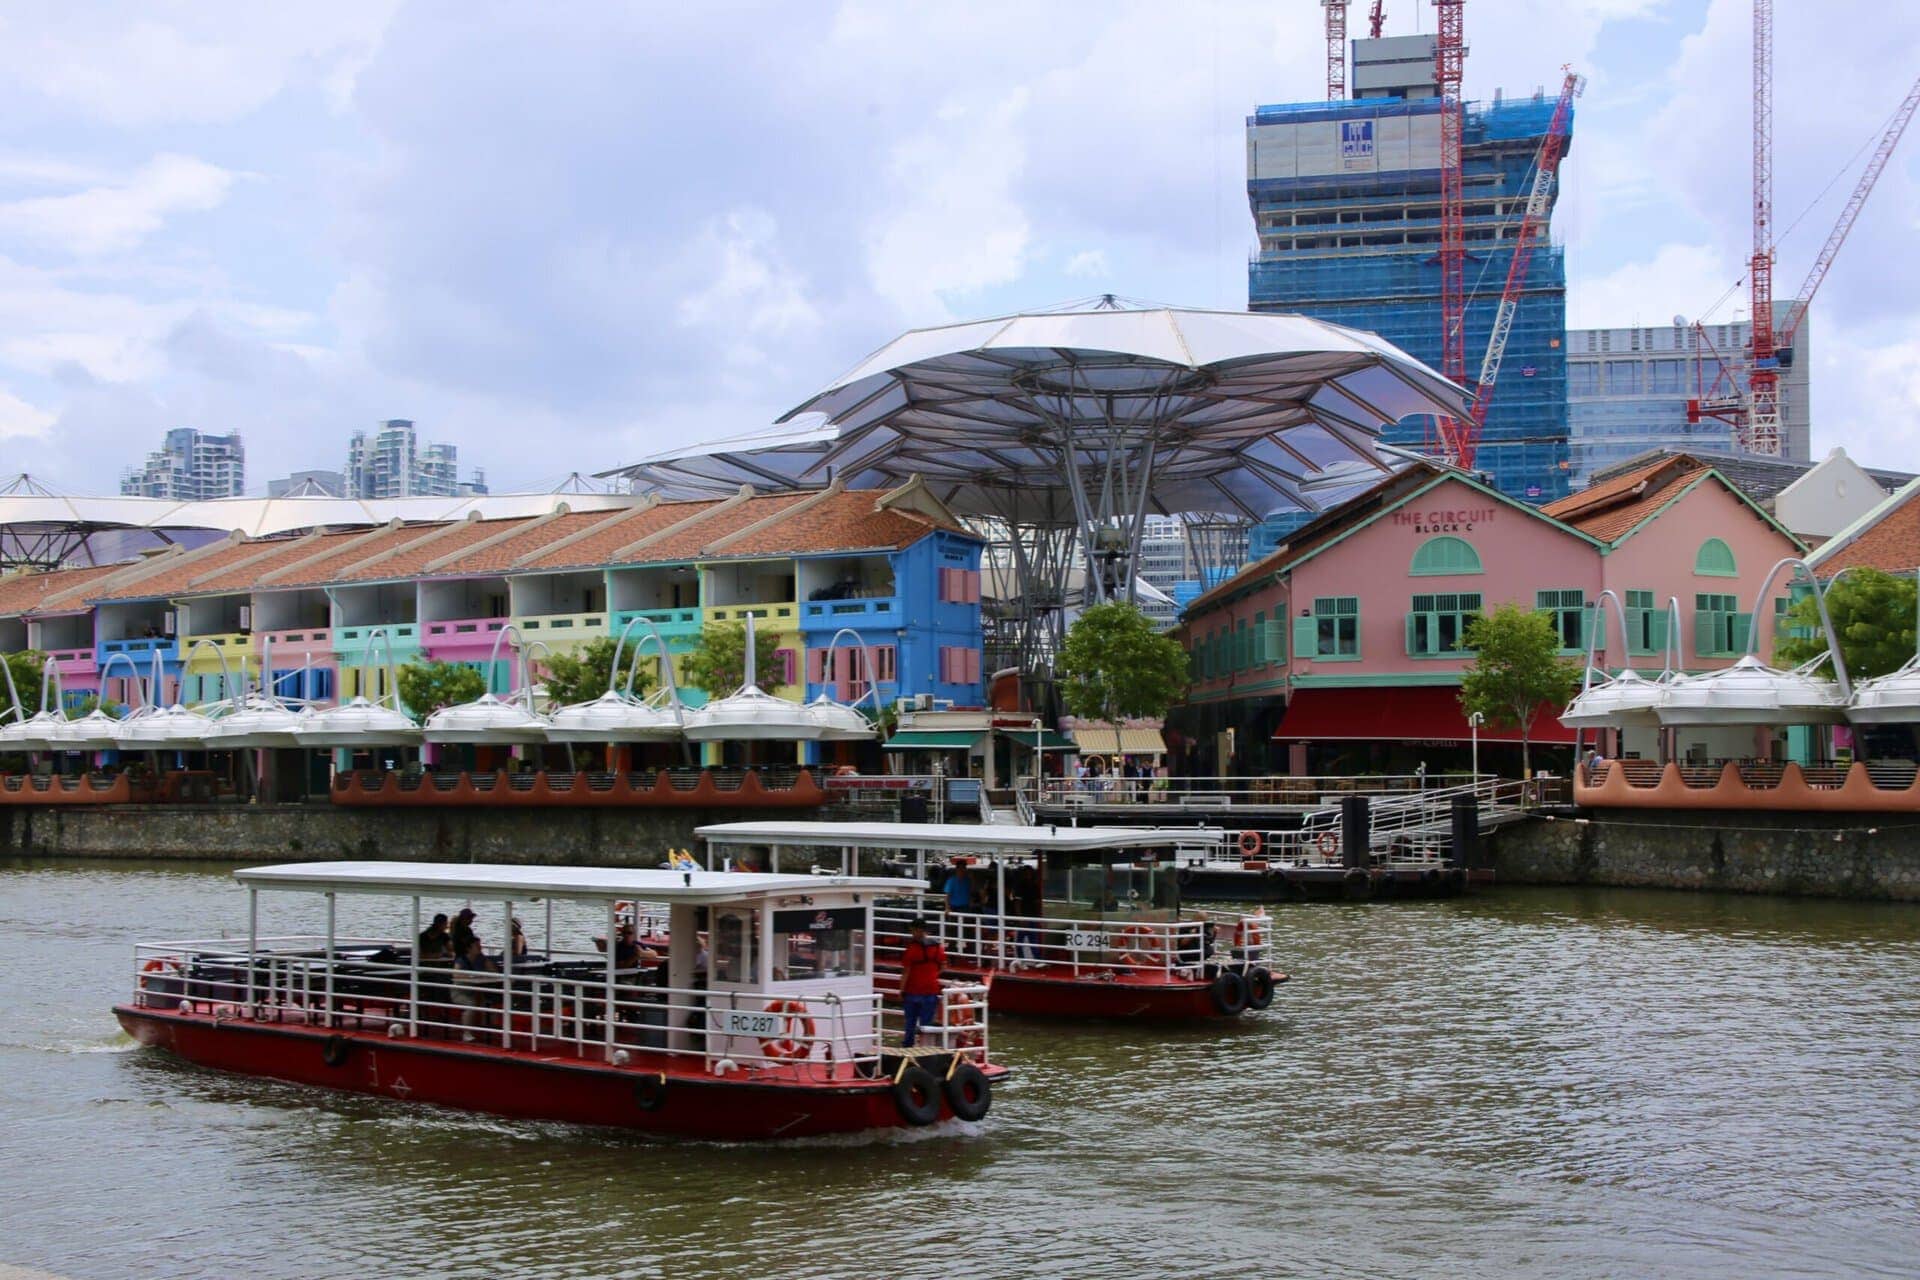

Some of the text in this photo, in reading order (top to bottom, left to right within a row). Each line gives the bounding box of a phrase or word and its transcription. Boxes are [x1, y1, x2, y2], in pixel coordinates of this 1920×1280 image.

[1392, 509, 1496, 525] THE CIRCUIT
[1415, 523, 1473, 533] BLOCK C
[1065, 933, 1109, 948] RC 294
[731, 1015, 774, 1032] RC 287
